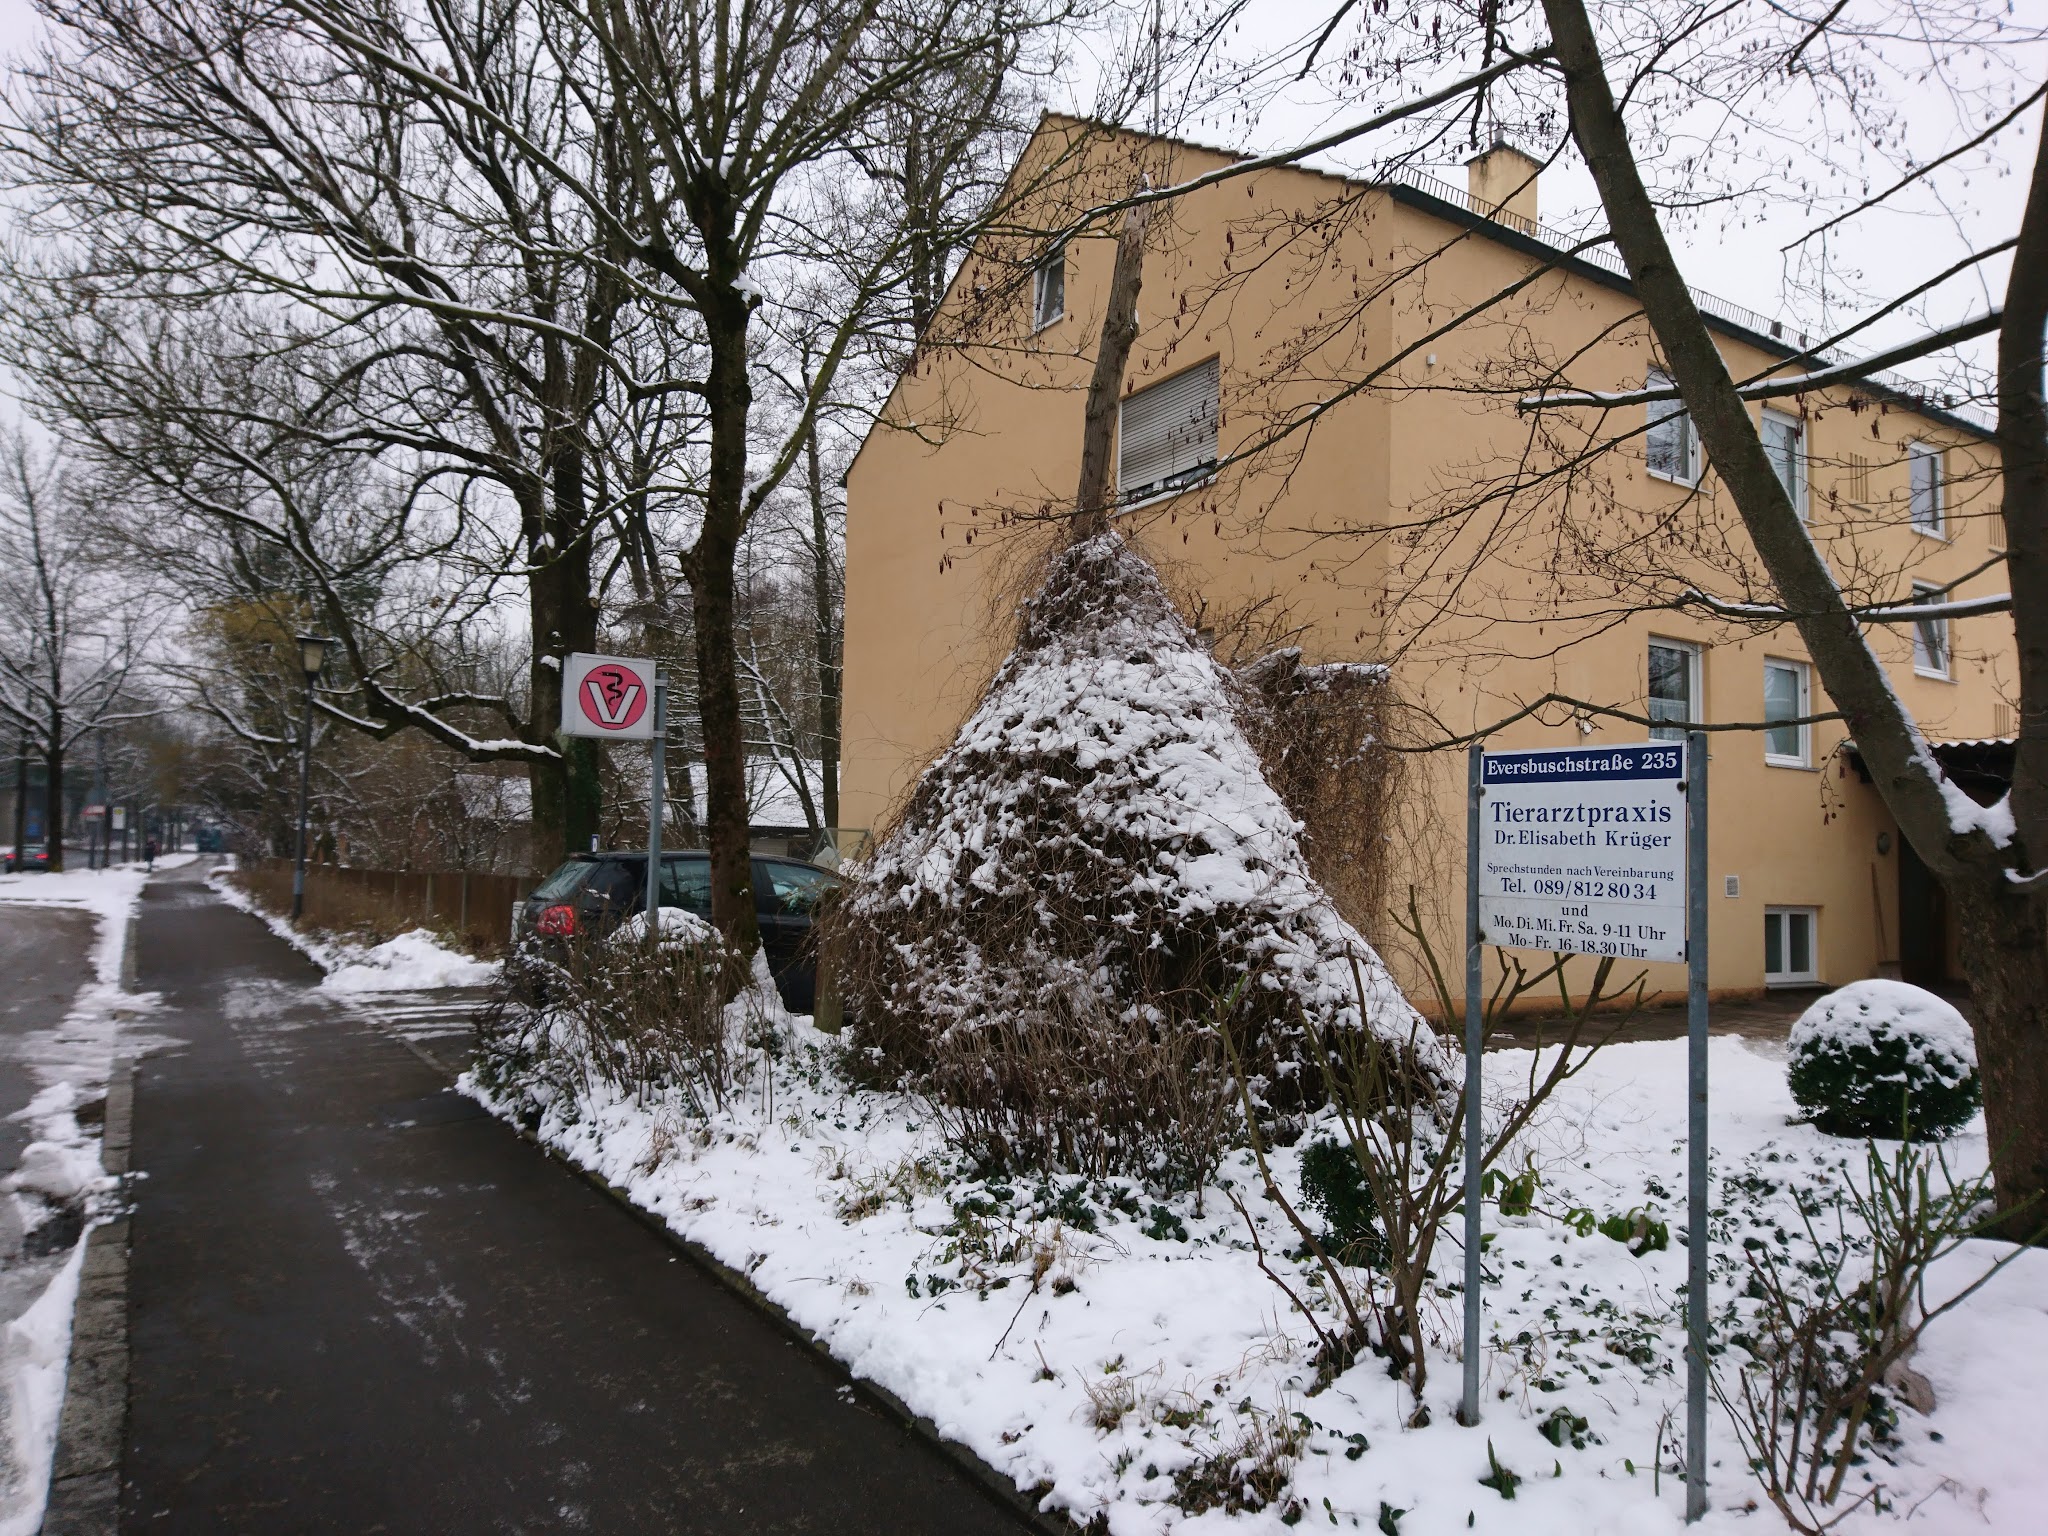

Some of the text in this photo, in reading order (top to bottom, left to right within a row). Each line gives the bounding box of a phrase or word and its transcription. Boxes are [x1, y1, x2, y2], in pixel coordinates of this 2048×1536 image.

[586, 681, 641, 724] V
[1487, 752, 1677, 775] Eversbuschstraße 235
[1491, 800, 1671, 827] Tierarztpraxis
[1605, 831, 1672, 850] Krüger
[1487, 863, 1674, 881] Sprechstunden nach Vereinbarung
[1501, 878, 1526, 893] Tel.
[1562, 905, 1588, 916] und
[1603, 923, 1631, 937] 9-11
[1639, 926, 1666, 940] Uhr
[1621, 943, 1648, 957] Uhr
